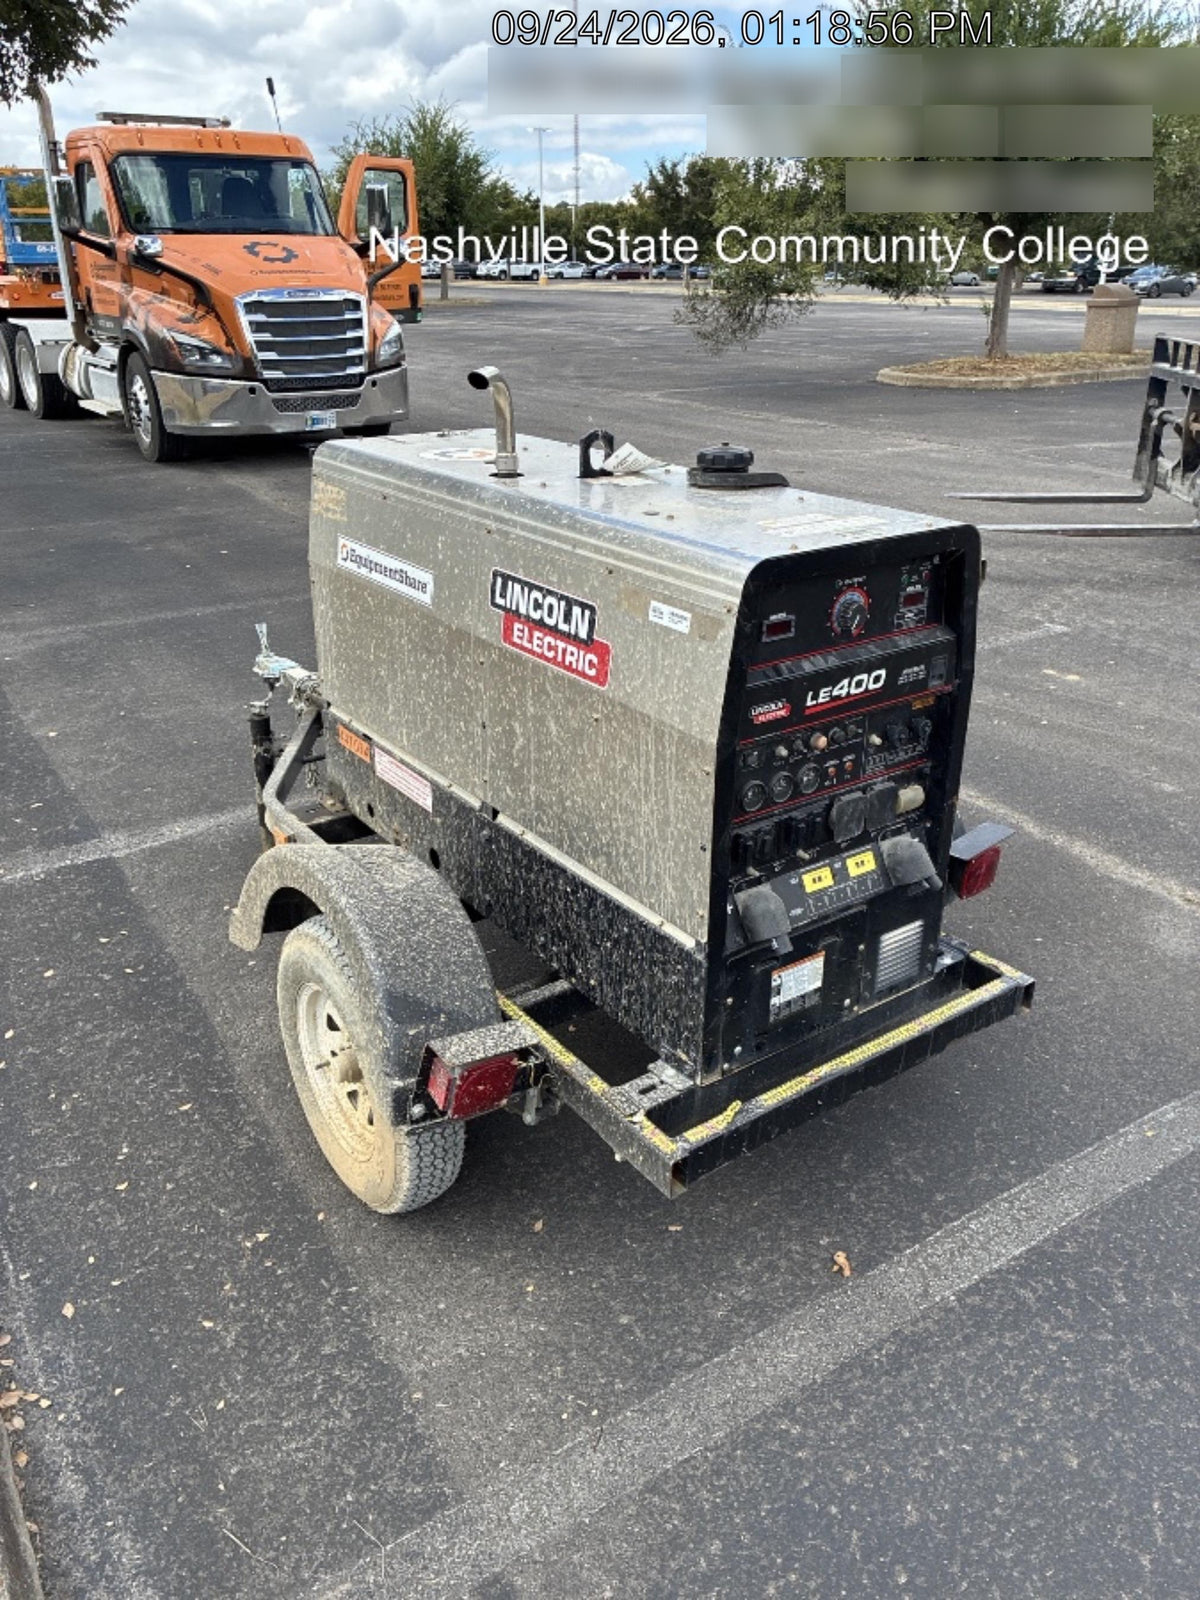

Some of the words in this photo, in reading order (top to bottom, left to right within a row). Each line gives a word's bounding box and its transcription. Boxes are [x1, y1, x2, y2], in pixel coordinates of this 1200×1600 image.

[494, 575, 591, 641] LINCOLN
[512, 621, 599, 677] ELECTRIC
[805, 668, 887, 707] LE400
